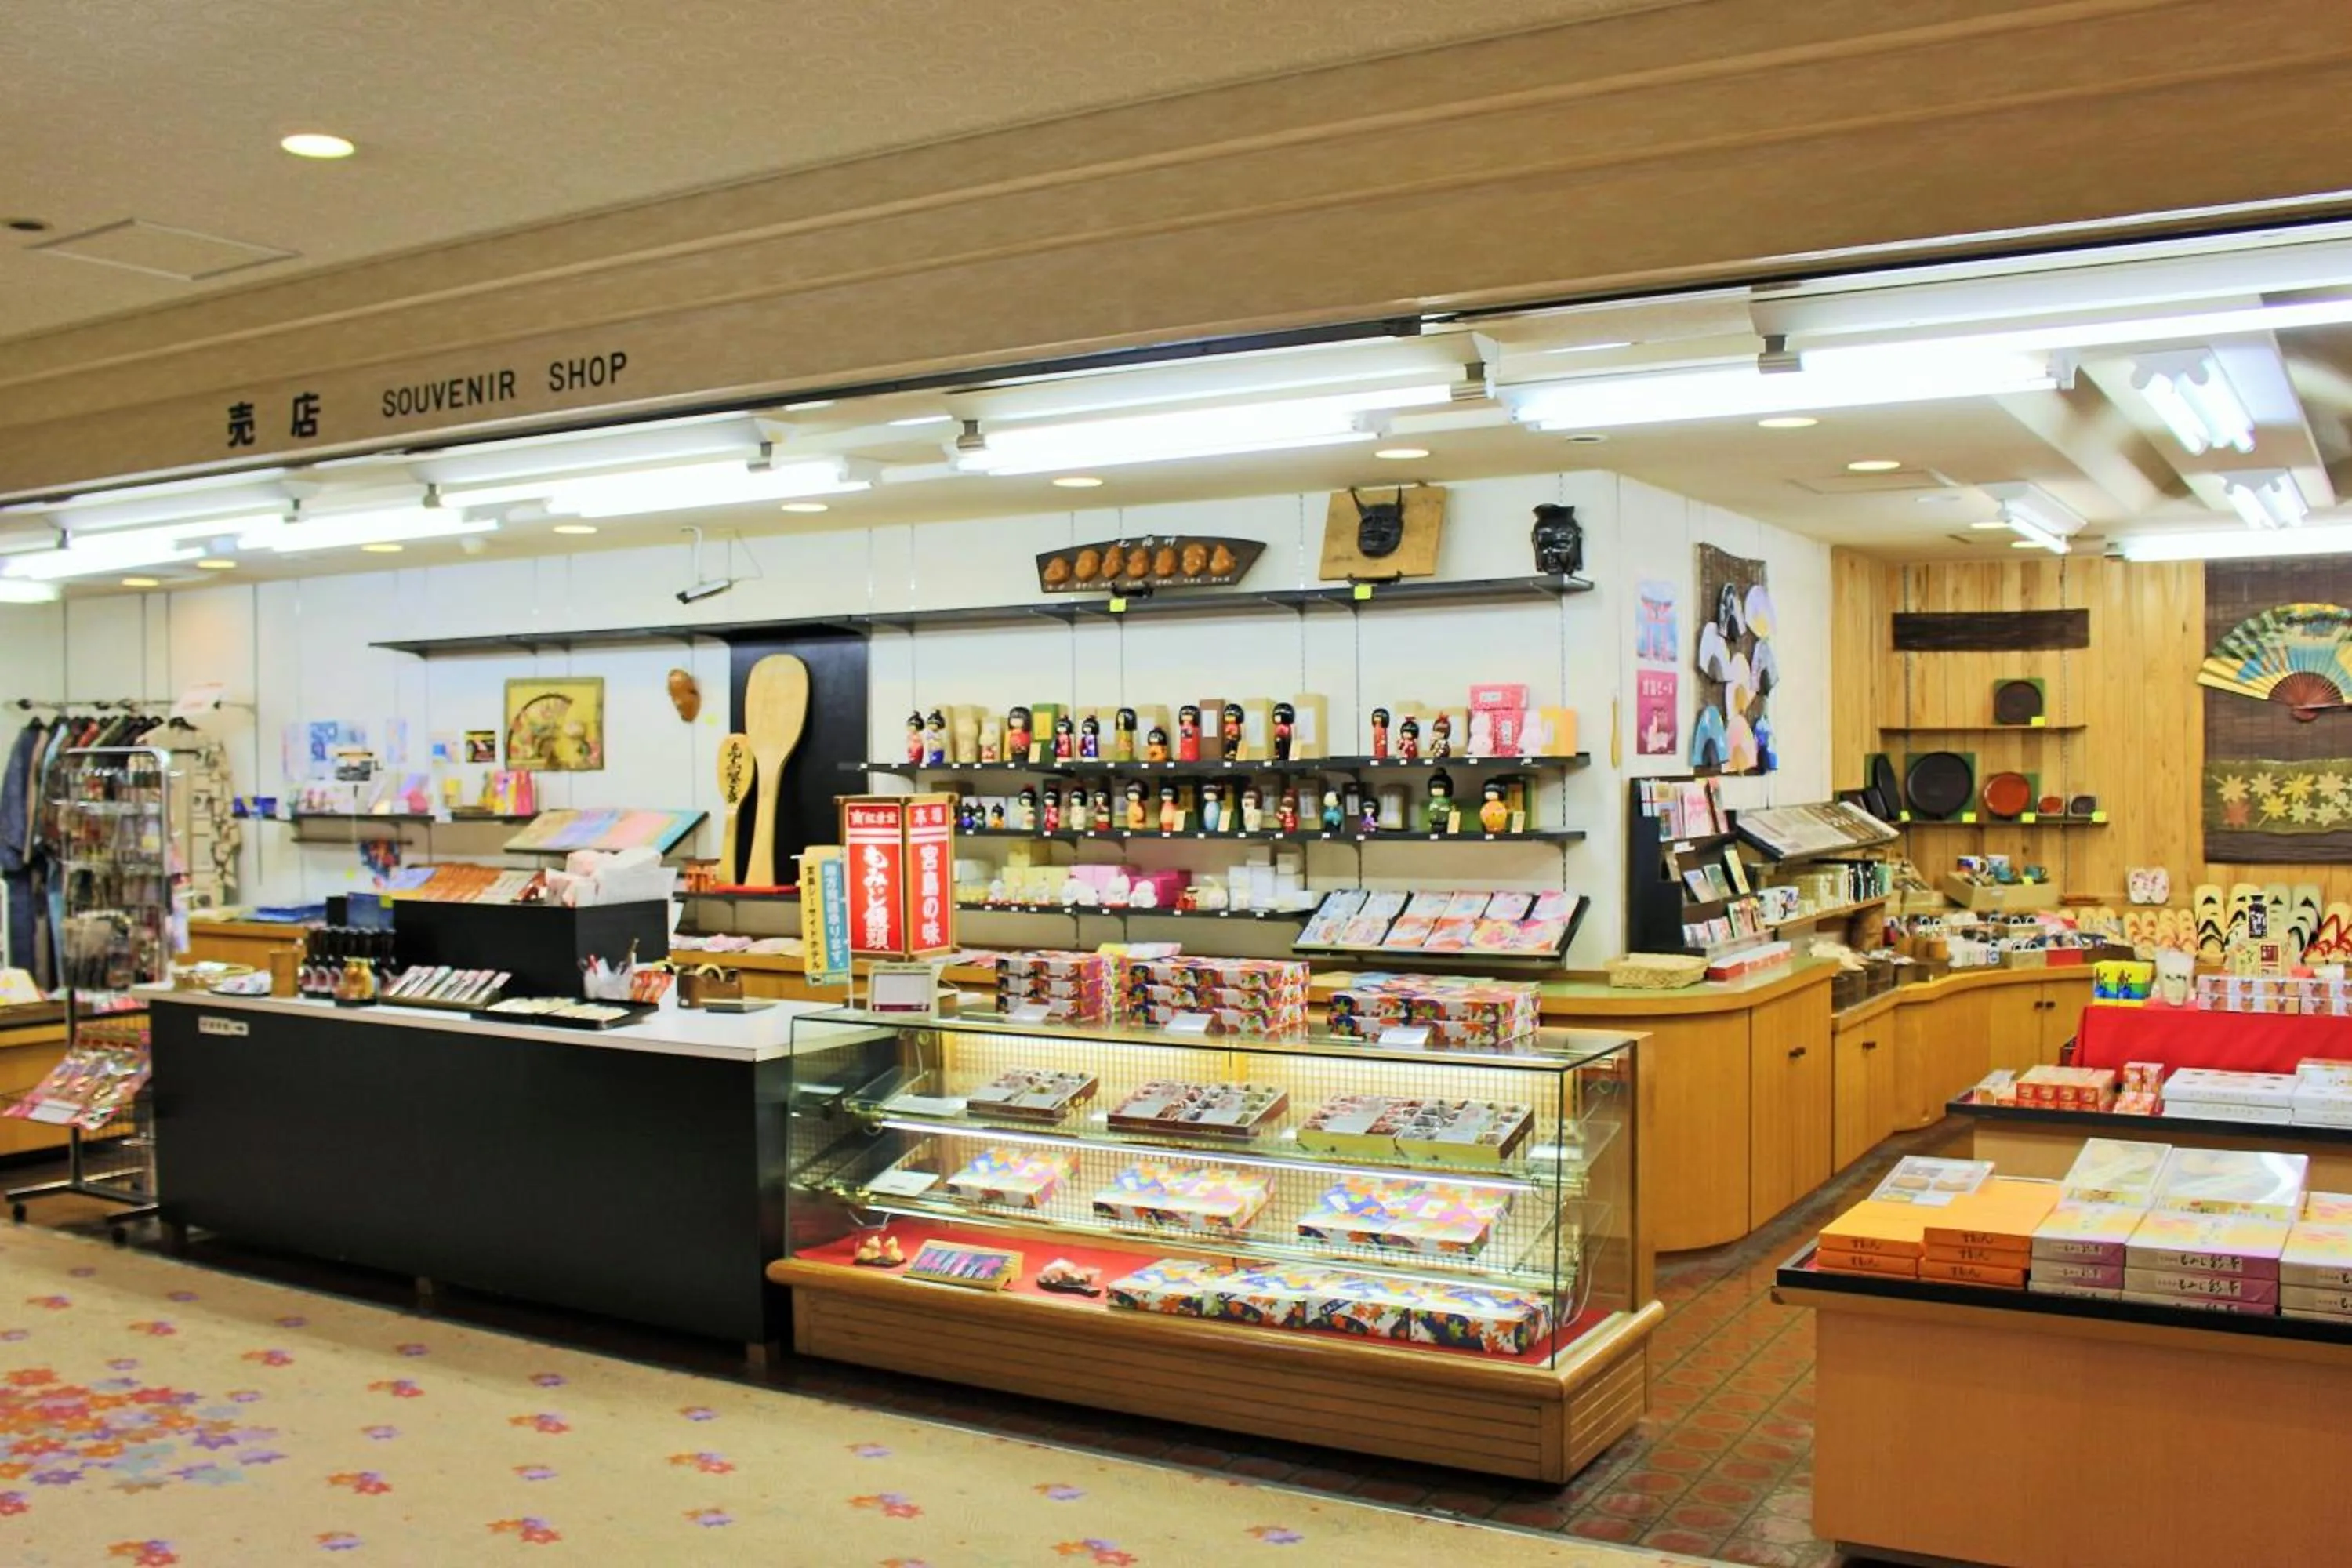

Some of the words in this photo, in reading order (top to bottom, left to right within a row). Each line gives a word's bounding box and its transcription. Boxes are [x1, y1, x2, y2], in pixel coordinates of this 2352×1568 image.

[228, 392, 321, 448] 売店
[383, 370, 516, 417] SOUVENIR
[550, 351, 626, 392] SHOP
[863, 844, 890, 949] もみじ饅頭
[920, 844, 941, 945] 宮島の味
